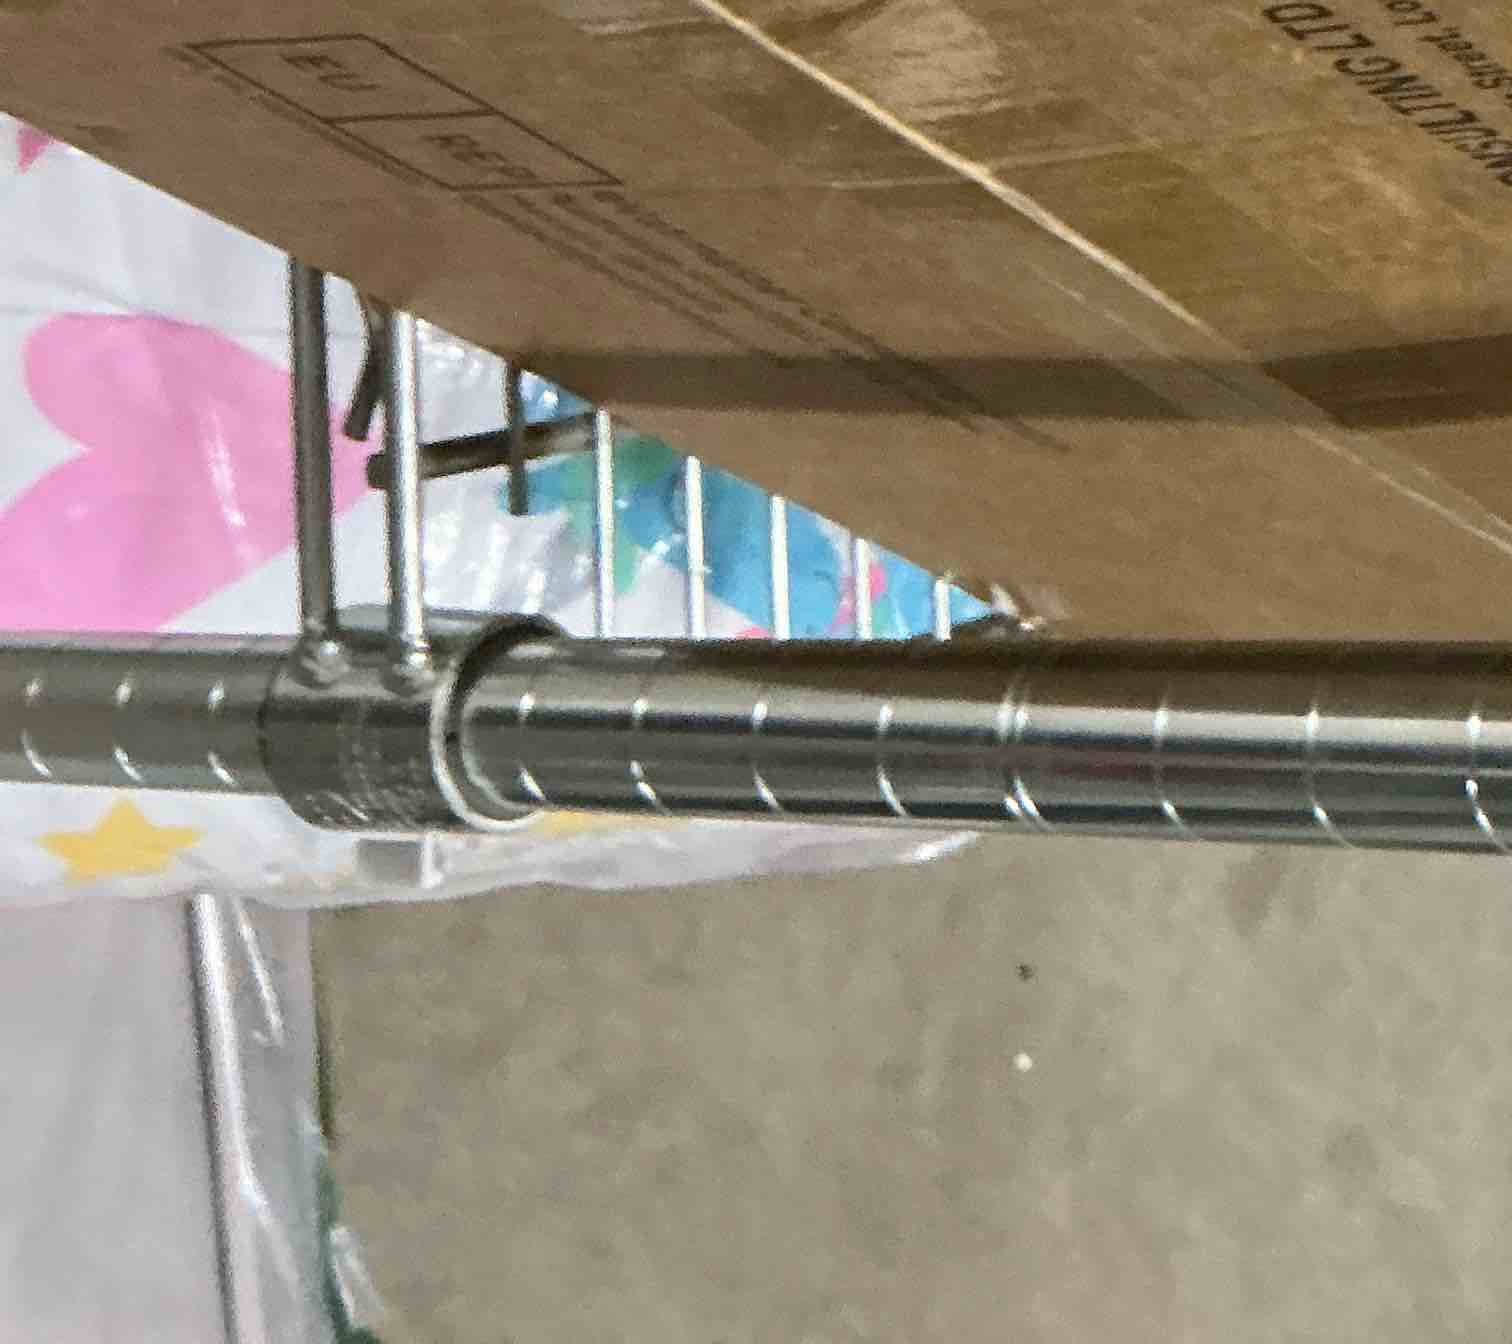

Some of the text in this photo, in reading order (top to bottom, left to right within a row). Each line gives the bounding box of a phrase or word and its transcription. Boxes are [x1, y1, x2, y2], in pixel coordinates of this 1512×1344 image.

[1261, 0, 1376, 53] LTD
[278, 52, 543, 185] EU REP
